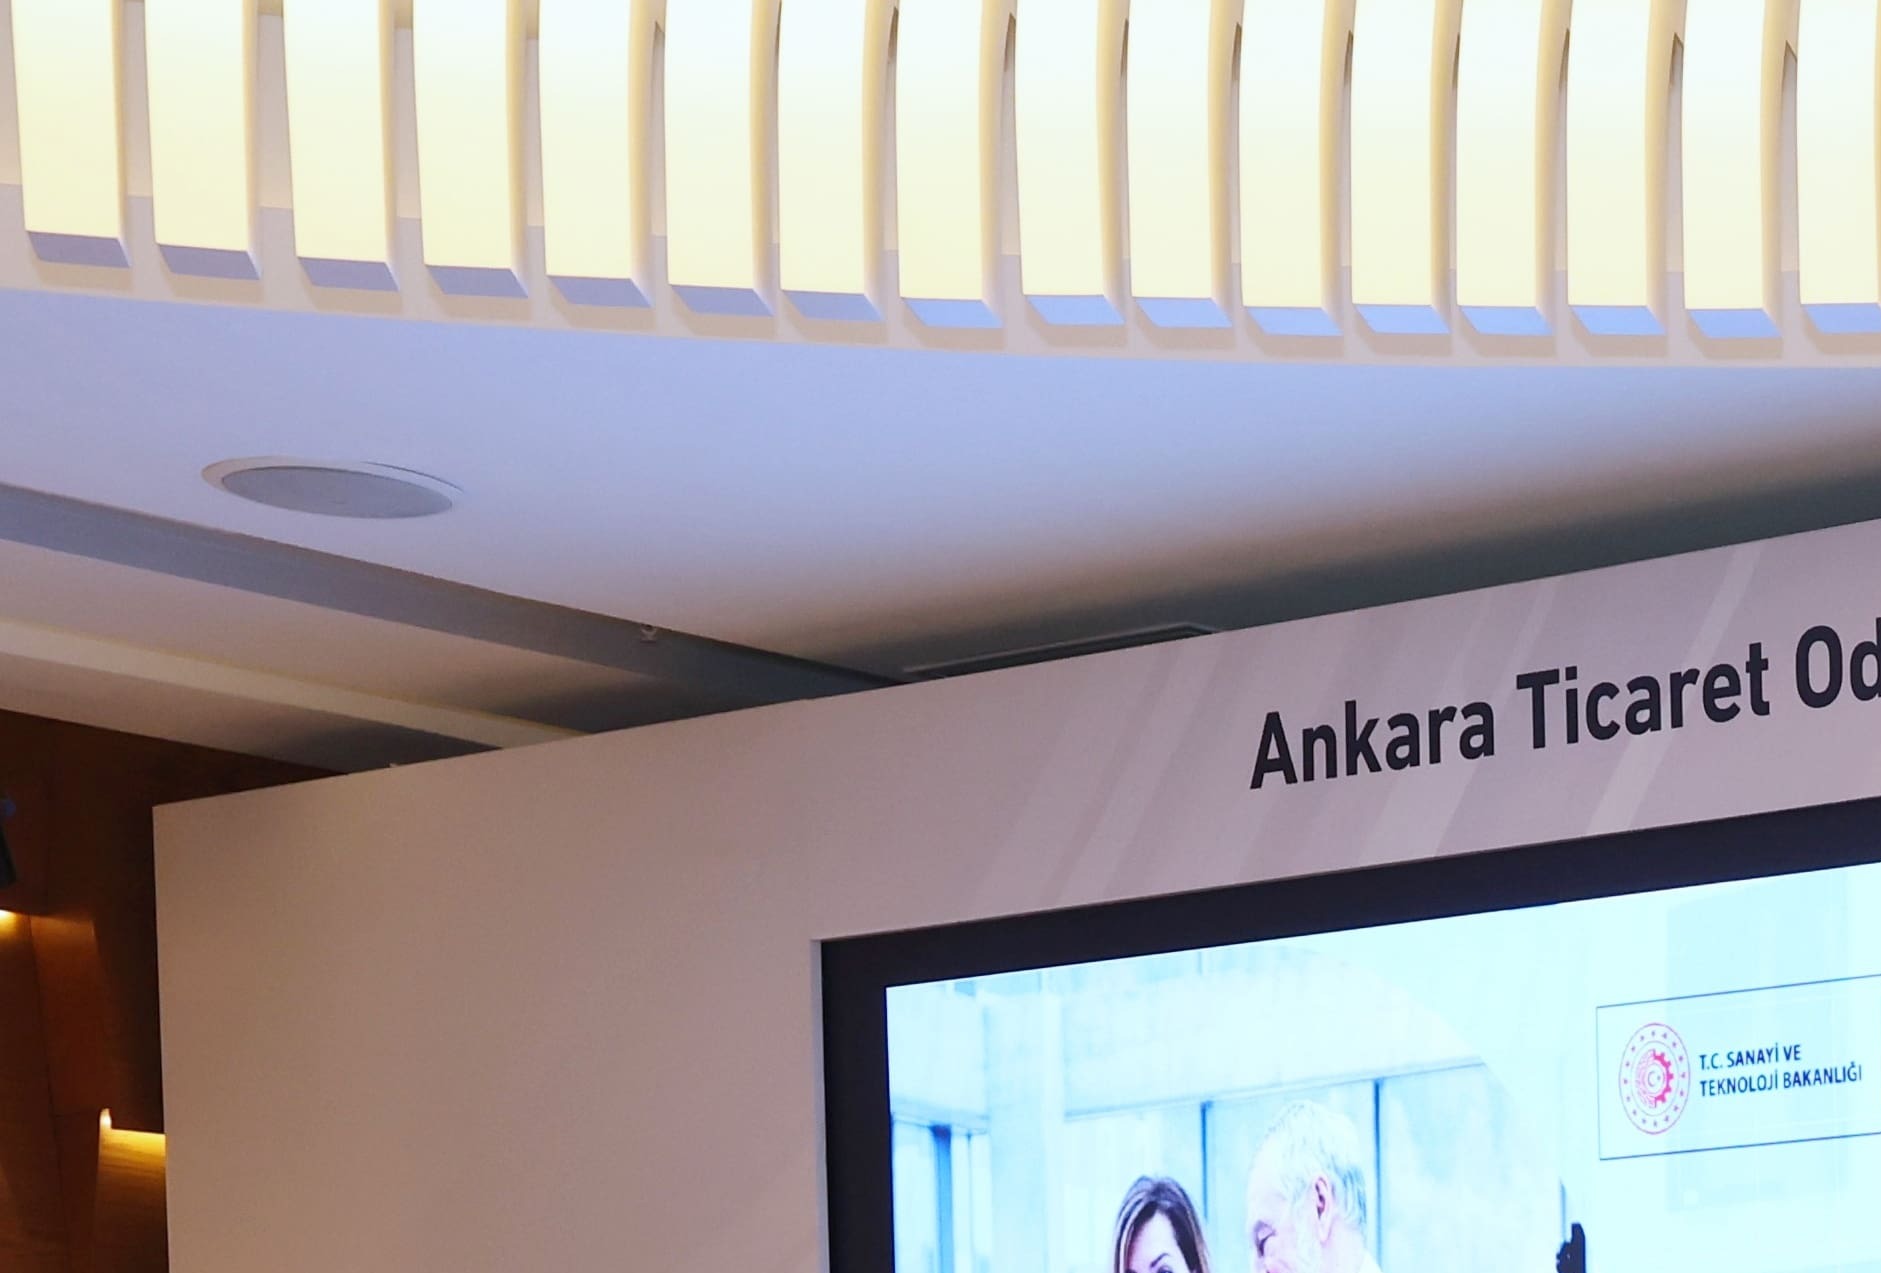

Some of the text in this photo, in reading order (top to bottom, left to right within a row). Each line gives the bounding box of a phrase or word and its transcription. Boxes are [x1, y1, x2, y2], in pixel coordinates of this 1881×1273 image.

[1250, 700, 1494, 789] Ankara
[1516, 642, 1770, 749] Ticaret
[1699, 1042, 1802, 1071] T.C. SANAYİ VE
[1699, 1061, 1863, 1097] TEKNOLOJİ BAKANLIĞI
